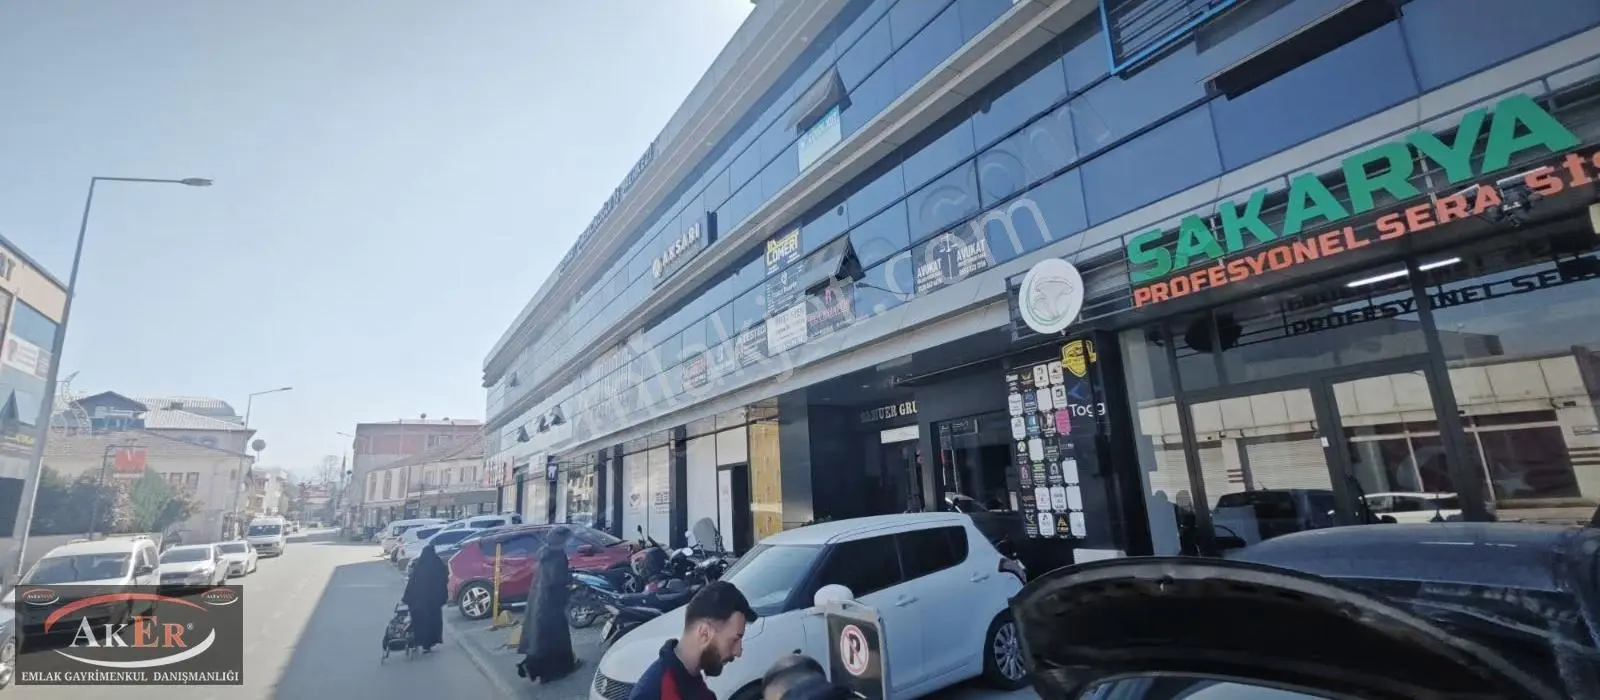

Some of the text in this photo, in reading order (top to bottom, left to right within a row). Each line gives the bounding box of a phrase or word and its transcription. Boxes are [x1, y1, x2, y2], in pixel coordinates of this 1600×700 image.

[1127, 92, 1582, 283] SAKARYA
[1134, 226, 1370, 308] PROFESYONEL
[1376, 185, 1503, 241] SERA
[1068, 402, 1105, 417] Togg
